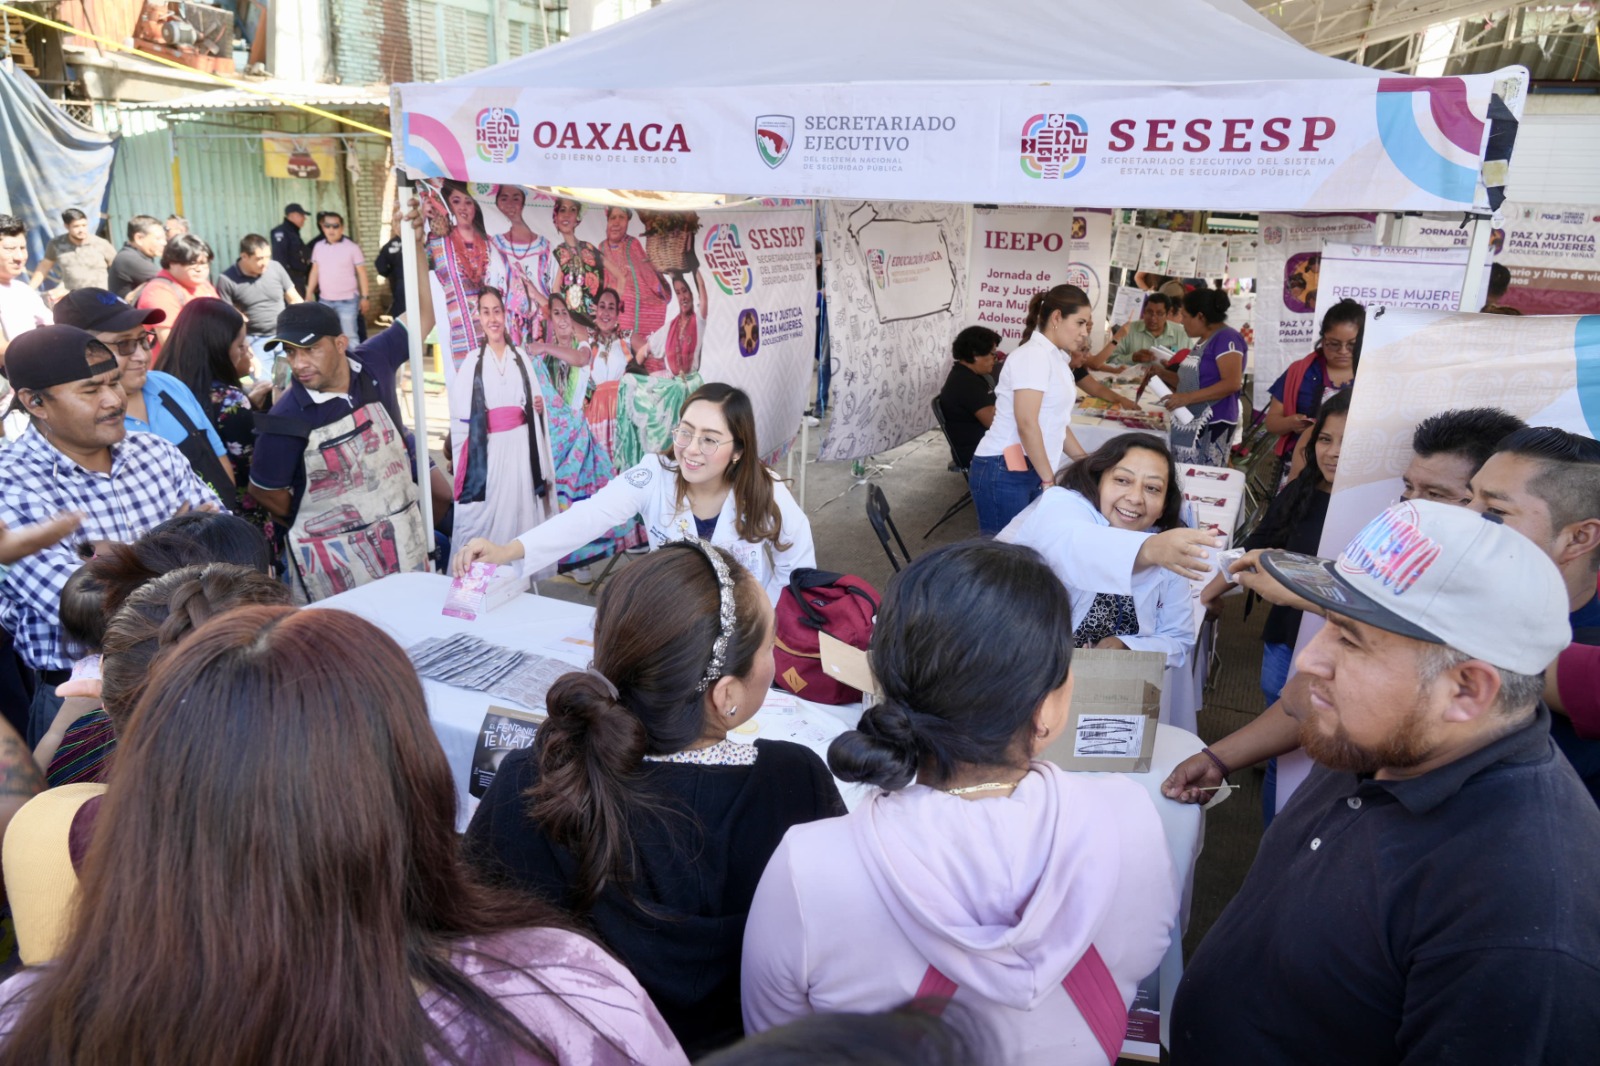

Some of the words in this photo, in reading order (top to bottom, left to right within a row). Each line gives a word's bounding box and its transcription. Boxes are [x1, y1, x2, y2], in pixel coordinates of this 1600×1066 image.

[805, 116, 956, 131] SECRETARIADO
[533, 121, 691, 152] OAXACA
[1108, 116, 1336, 152] SESESP
[804, 136, 910, 152] EJECUTIVO
[544, 153, 602, 162] GOBIERNO
[607, 154, 628, 163] DEL
[633, 155, 677, 164] ESTADO
[803, 155, 819, 163] DEL
[1100, 157, 1185, 165] SECRETARIADO
[1284, 157, 1335, 165] SISTEMA
[867, 164, 903, 172] PÚBLICA
[1189, 168, 1256, 176] SEGURIDAD
[1261, 167, 1312, 176] PÚBLICA
[748, 226, 805, 250] SESESP
[1419, 227, 1469, 237] JORNADA
[1511, 231, 1534, 240] PAZ
[1536, 232, 1543, 240] Y
[1545, 233, 1596, 243] JUSTICIA
[984, 230, 1064, 252] IEEPO
[1453, 238, 1468, 246] DE
[1509, 240, 1539, 248] PARA
[1541, 241, 1596, 252] MUJERES,
[1508, 248, 1564, 257] ADOLESCENTES
[1571, 251, 1595, 259] NIÑAS
[987, 268, 1032, 282] Jornada
[1036, 270, 1051, 281] de
[1533, 270, 1541, 279] y
[1543, 269, 1568, 279] libre
[1570, 271, 1584, 280] de
[981, 283, 999, 294] Paz
[1002, 286, 1010, 297] y
[1012, 284, 1051, 296] Justici
[1332, 286, 1377, 298] REDES
[1381, 288, 1400, 300] DE
[1403, 289, 1460, 301] MUJERE
[978, 299, 1003, 309] para
[1006, 299, 1028, 312] Muj
[761, 311, 773, 324] PAZ
[774, 311, 778, 321] Y
[978, 311, 1027, 324] Adolesce
[1300, 319, 1306, 327] Y
[762, 325, 777, 336] PARA
[1001, 328, 1023, 339] Niñ
[484, 730, 497, 748] TE
